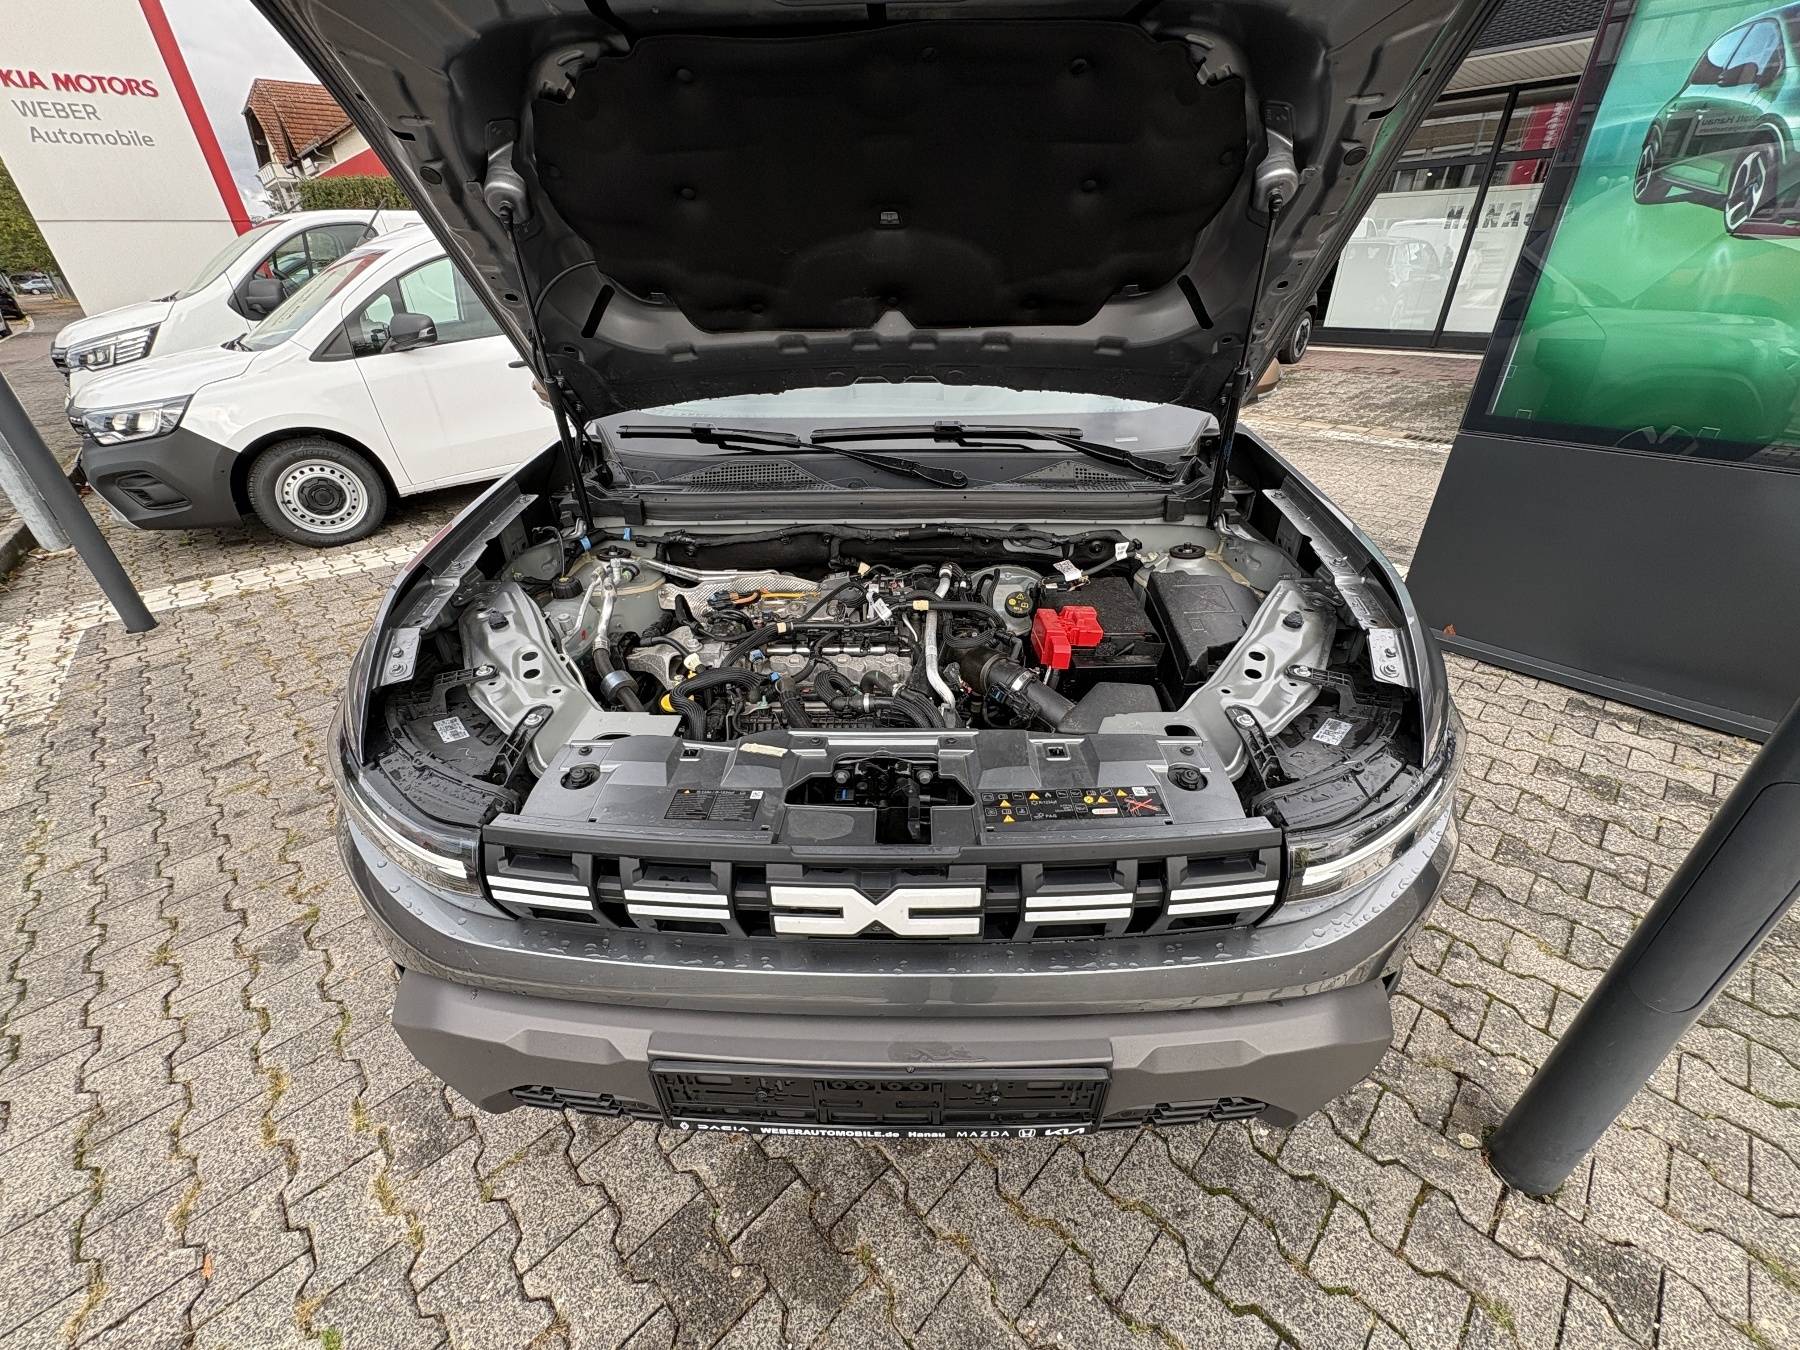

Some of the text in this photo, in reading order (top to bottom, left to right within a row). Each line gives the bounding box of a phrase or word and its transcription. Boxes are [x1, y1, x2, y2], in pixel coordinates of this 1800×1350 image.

[0, 69, 159, 98] KIA MOTORS
[11, 99, 102, 120] WEBER
[30, 126, 155, 146] Automobile
[760, 1127, 900, 1138] WEBERAUTOMOBILE.de
[956, 1130, 1010, 1138] MAZDA
